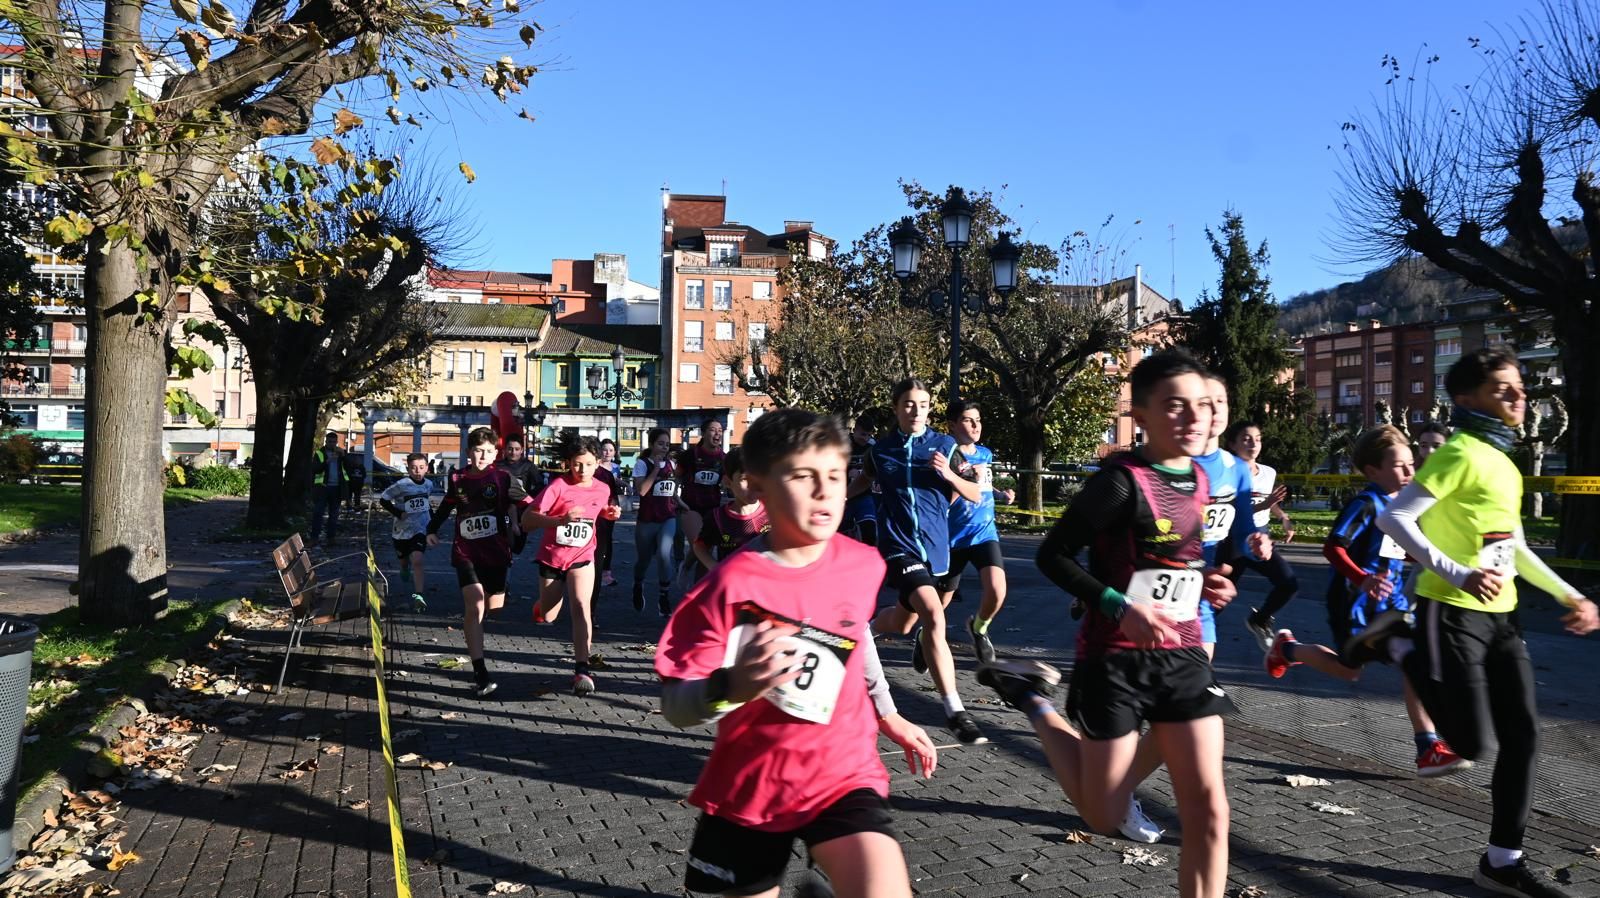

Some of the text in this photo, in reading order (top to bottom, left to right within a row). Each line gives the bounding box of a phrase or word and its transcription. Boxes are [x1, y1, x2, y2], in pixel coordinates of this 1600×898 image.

[701, 472, 714, 480] 317
[660, 481, 673, 491] 347
[409, 498, 425, 508] 325
[466, 516, 490, 532] 346
[564, 524, 587, 539] 305
